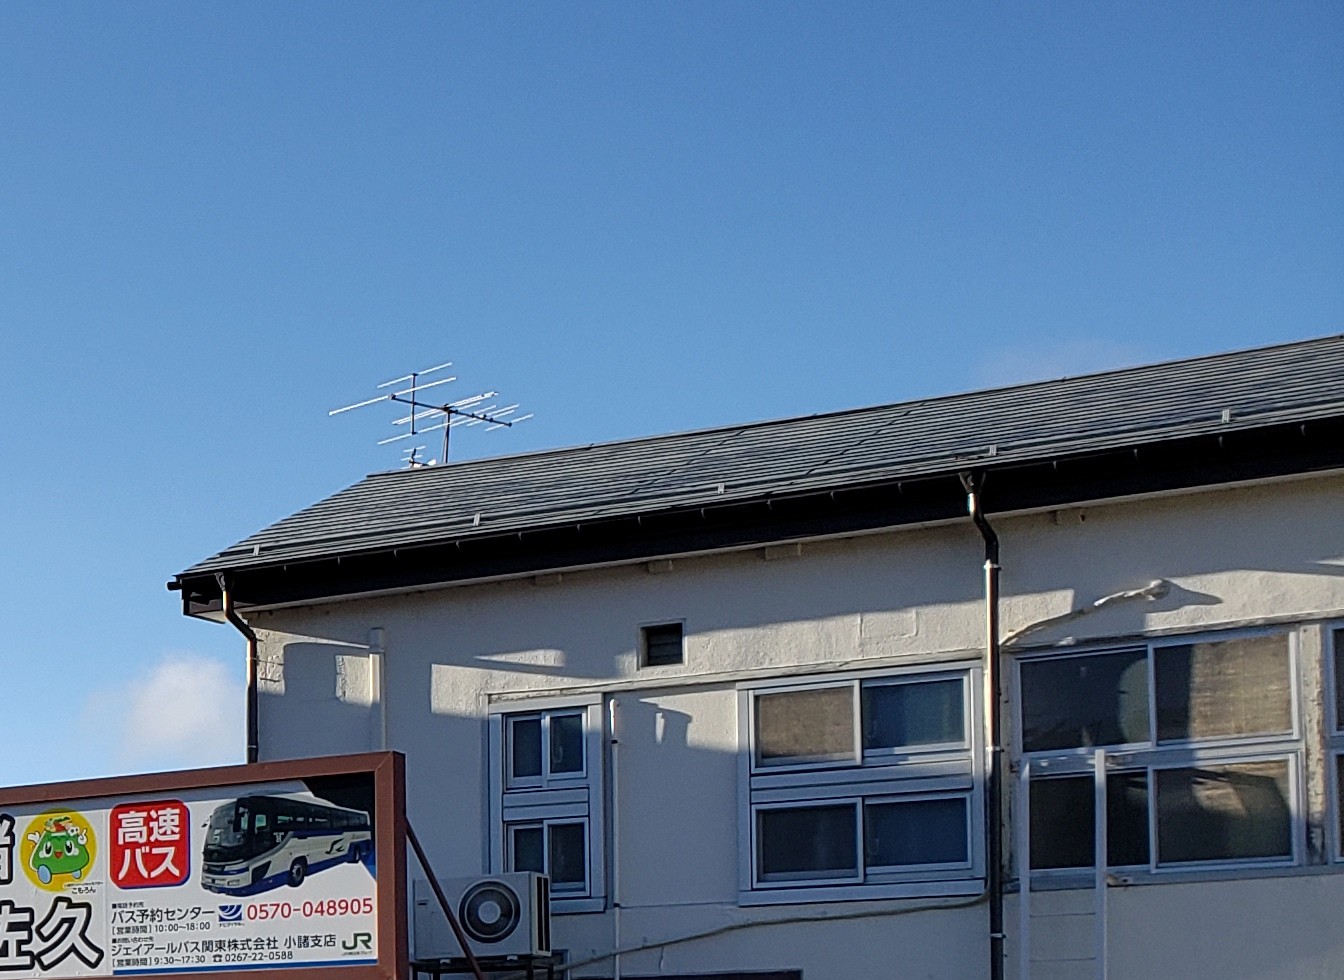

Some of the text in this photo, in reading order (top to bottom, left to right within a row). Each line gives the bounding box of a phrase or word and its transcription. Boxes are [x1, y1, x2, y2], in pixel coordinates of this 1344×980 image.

[116, 807, 182, 845] 高速
[117, 844, 181, 881] バス
[111, 906, 215, 925] バス予約センター
[246, 897, 374, 921] 0570-048905
[111, 933, 337, 957] ジェイアールバス関東株式会社 小諸支店
[341, 931, 373, 951] JR
